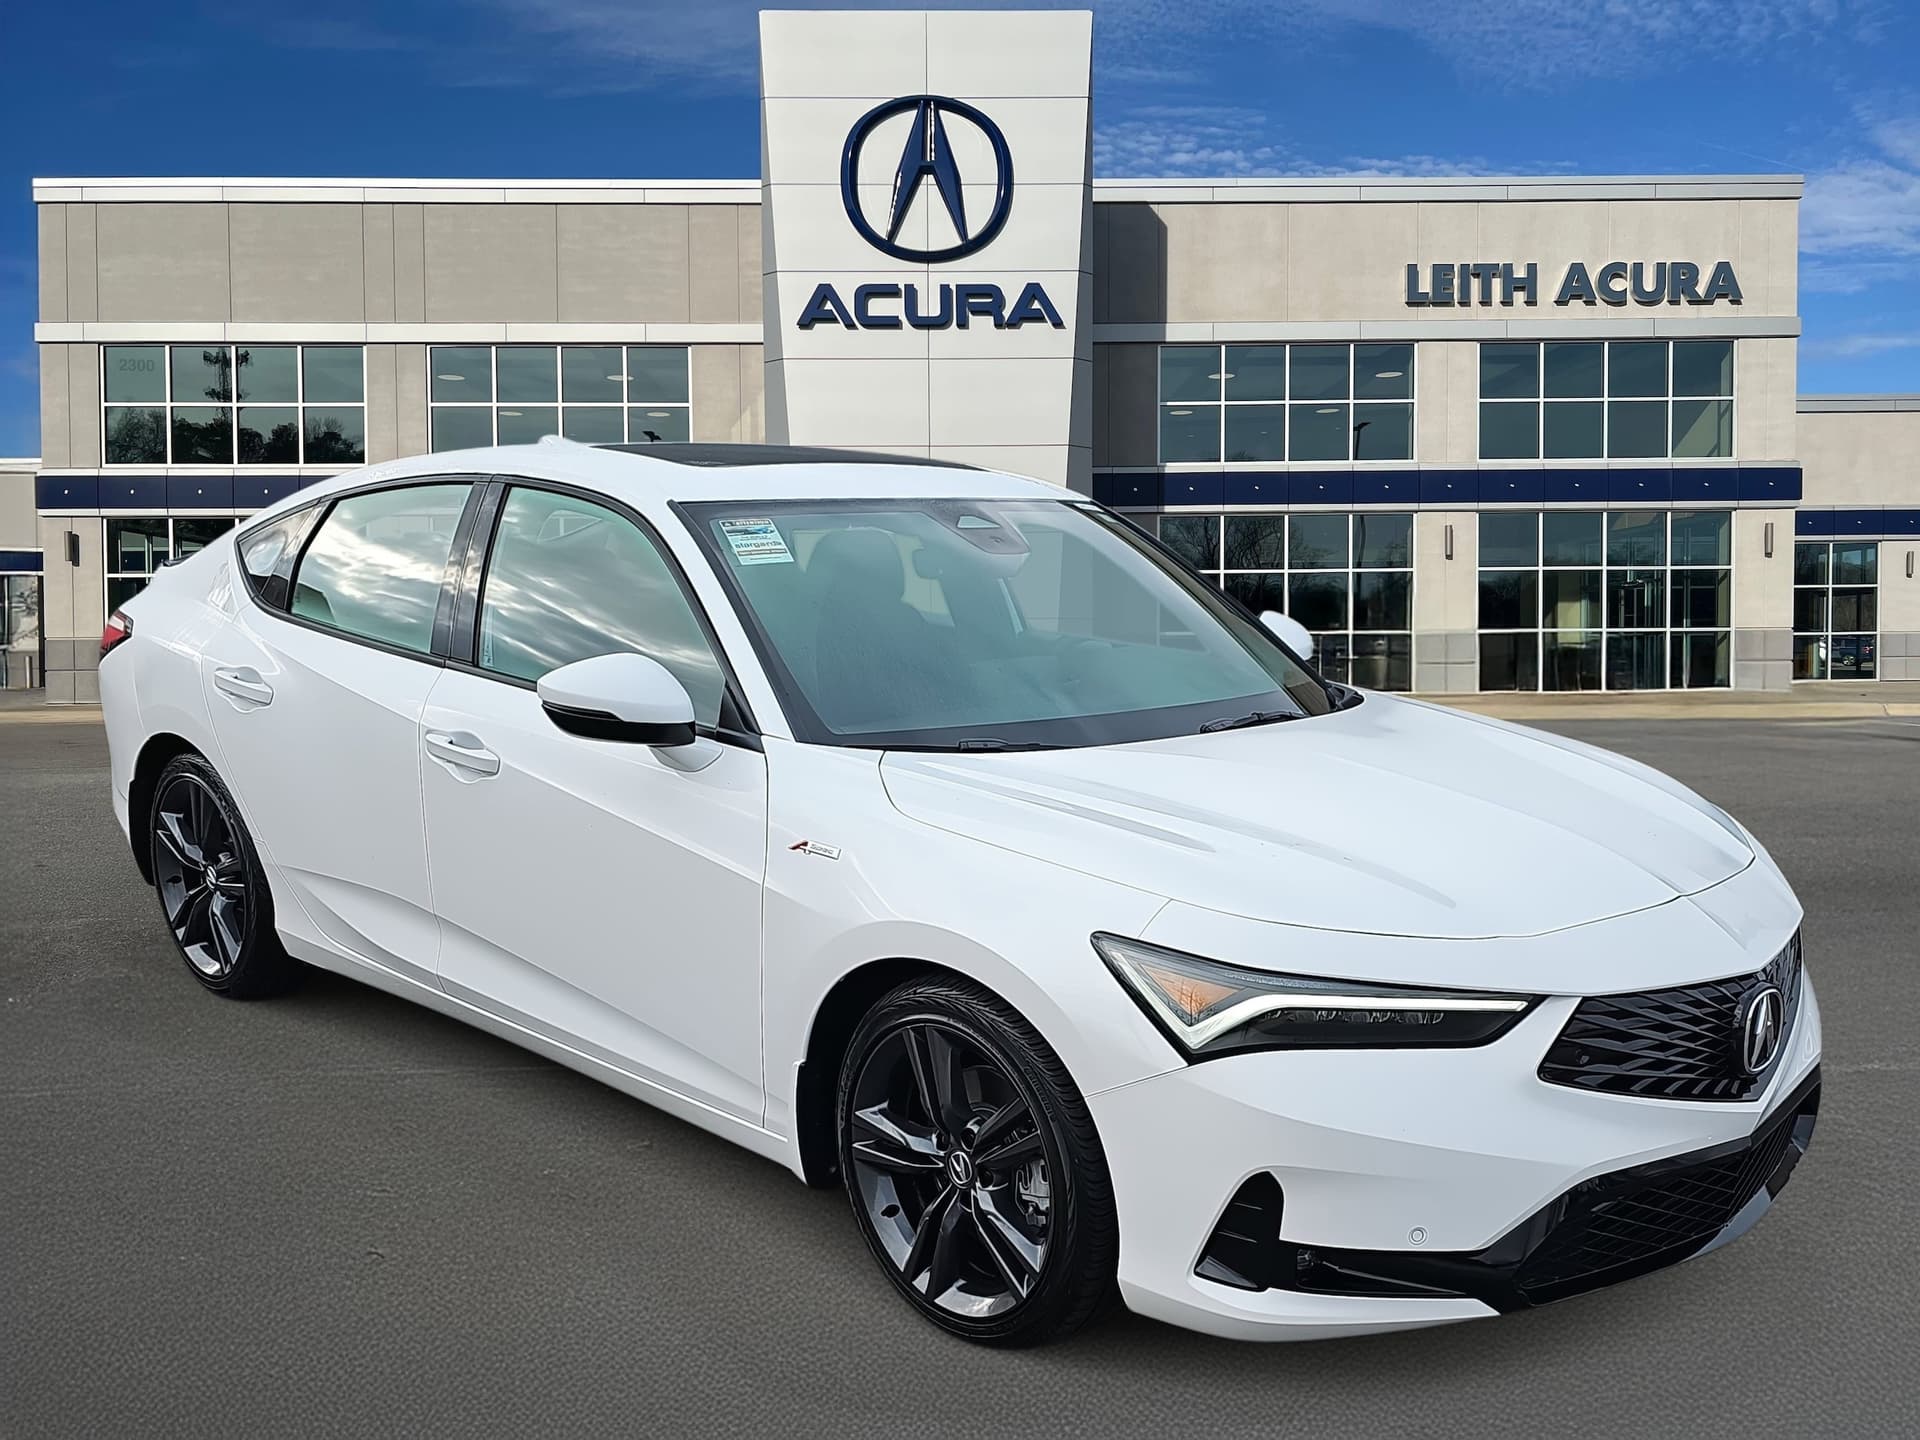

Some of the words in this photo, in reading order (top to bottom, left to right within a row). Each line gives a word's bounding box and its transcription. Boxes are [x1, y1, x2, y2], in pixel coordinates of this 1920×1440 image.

[797, 282, 1066, 330] ACURA
[1405, 263, 1538, 308] LEITH
[1553, 261, 1743, 307] ACURA
[119, 358, 154, 372] 2300
